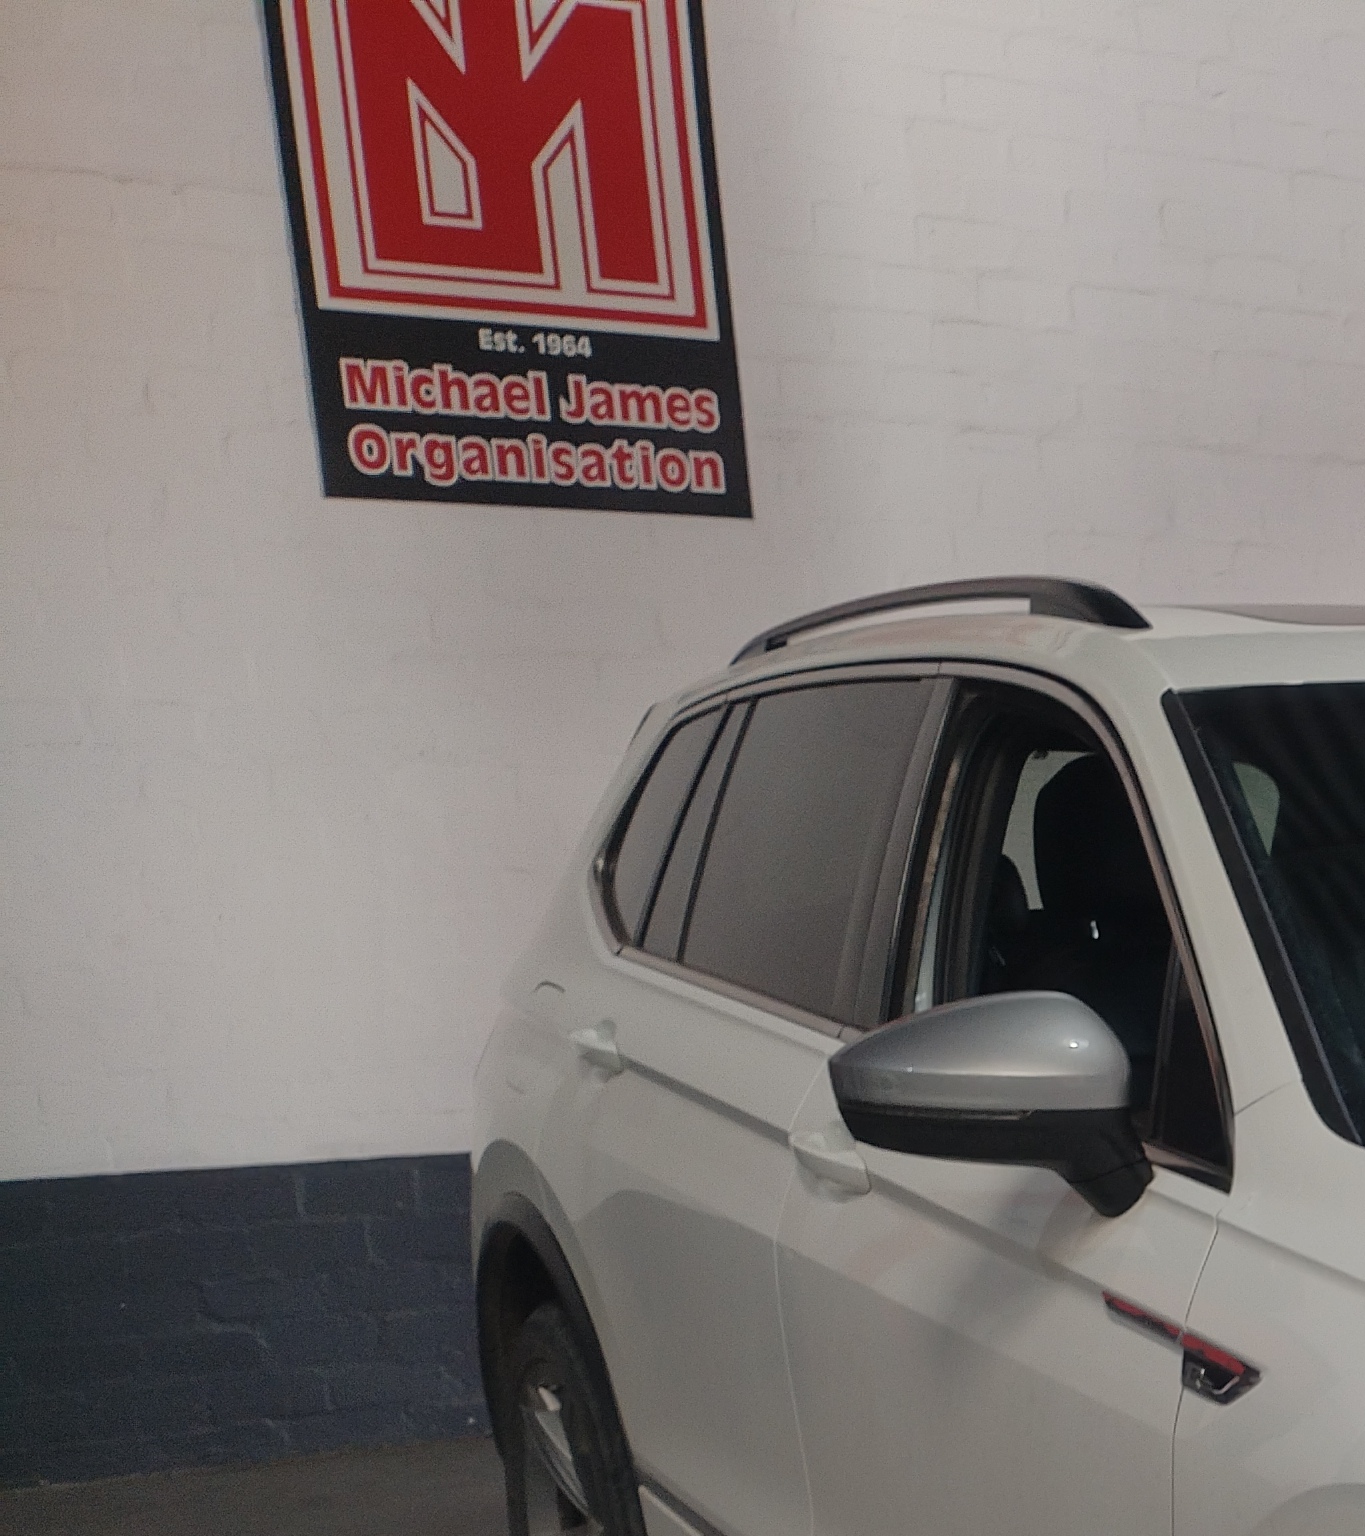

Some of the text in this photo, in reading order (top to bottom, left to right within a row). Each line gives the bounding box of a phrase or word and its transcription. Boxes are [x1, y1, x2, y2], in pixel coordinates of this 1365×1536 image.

[478, 328, 593, 358] Est. 1964
[339, 357, 721, 433] Michael James
[347, 422, 727, 495] Organisation
